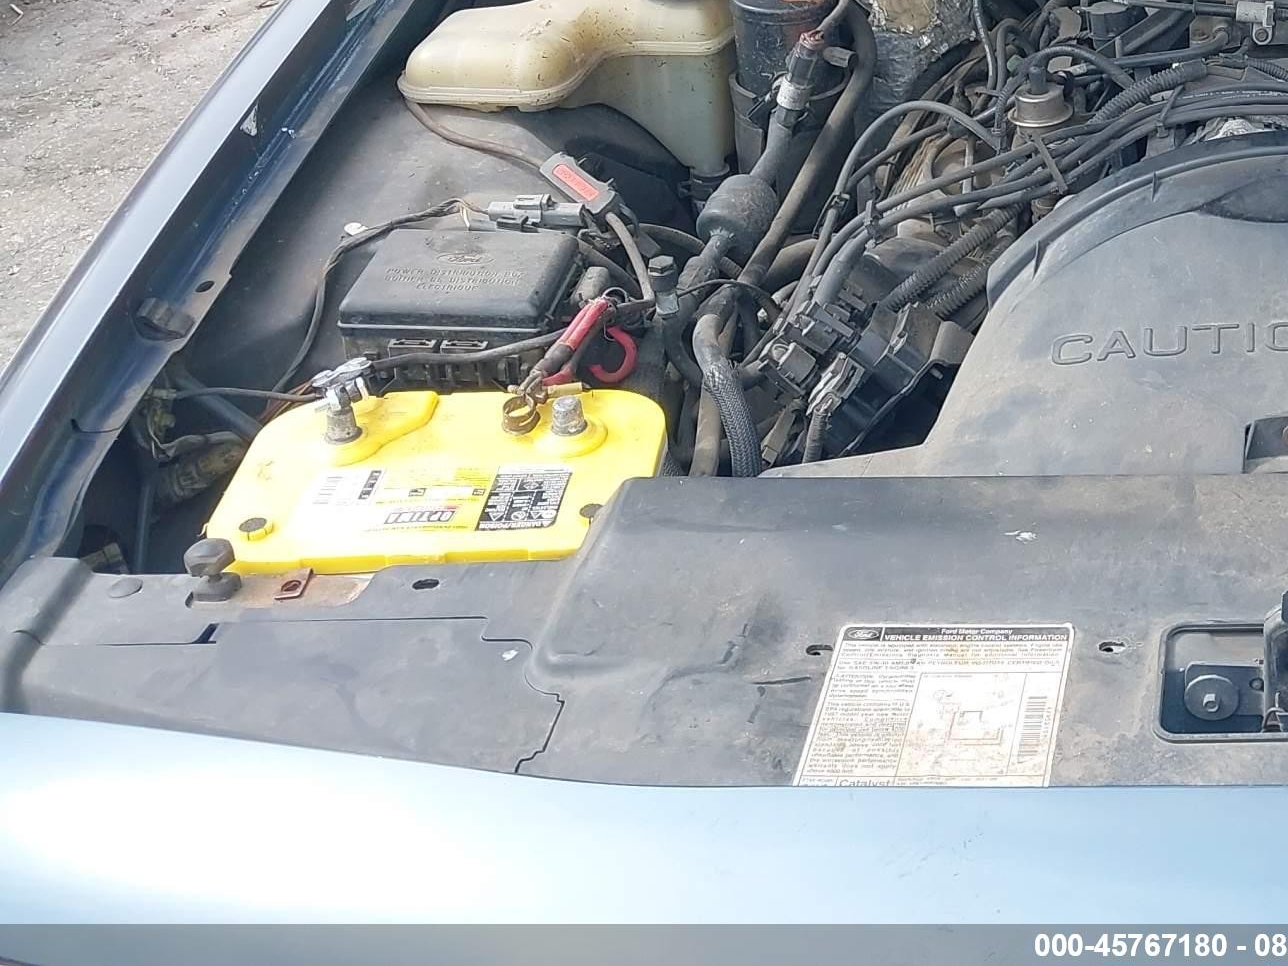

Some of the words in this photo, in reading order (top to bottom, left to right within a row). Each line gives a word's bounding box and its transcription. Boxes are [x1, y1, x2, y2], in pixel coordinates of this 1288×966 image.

[384, 511, 457, 525] OPTIMA
[980, 628, 1013, 636] Company
[885, 634, 921, 642] VEHICLE
[922, 634, 963, 642] EMISSION
[965, 634, 1008, 642] CONTROL
[1009, 634, 1067, 642] INFORMATION
[839, 778, 890, 787] Catalyst
